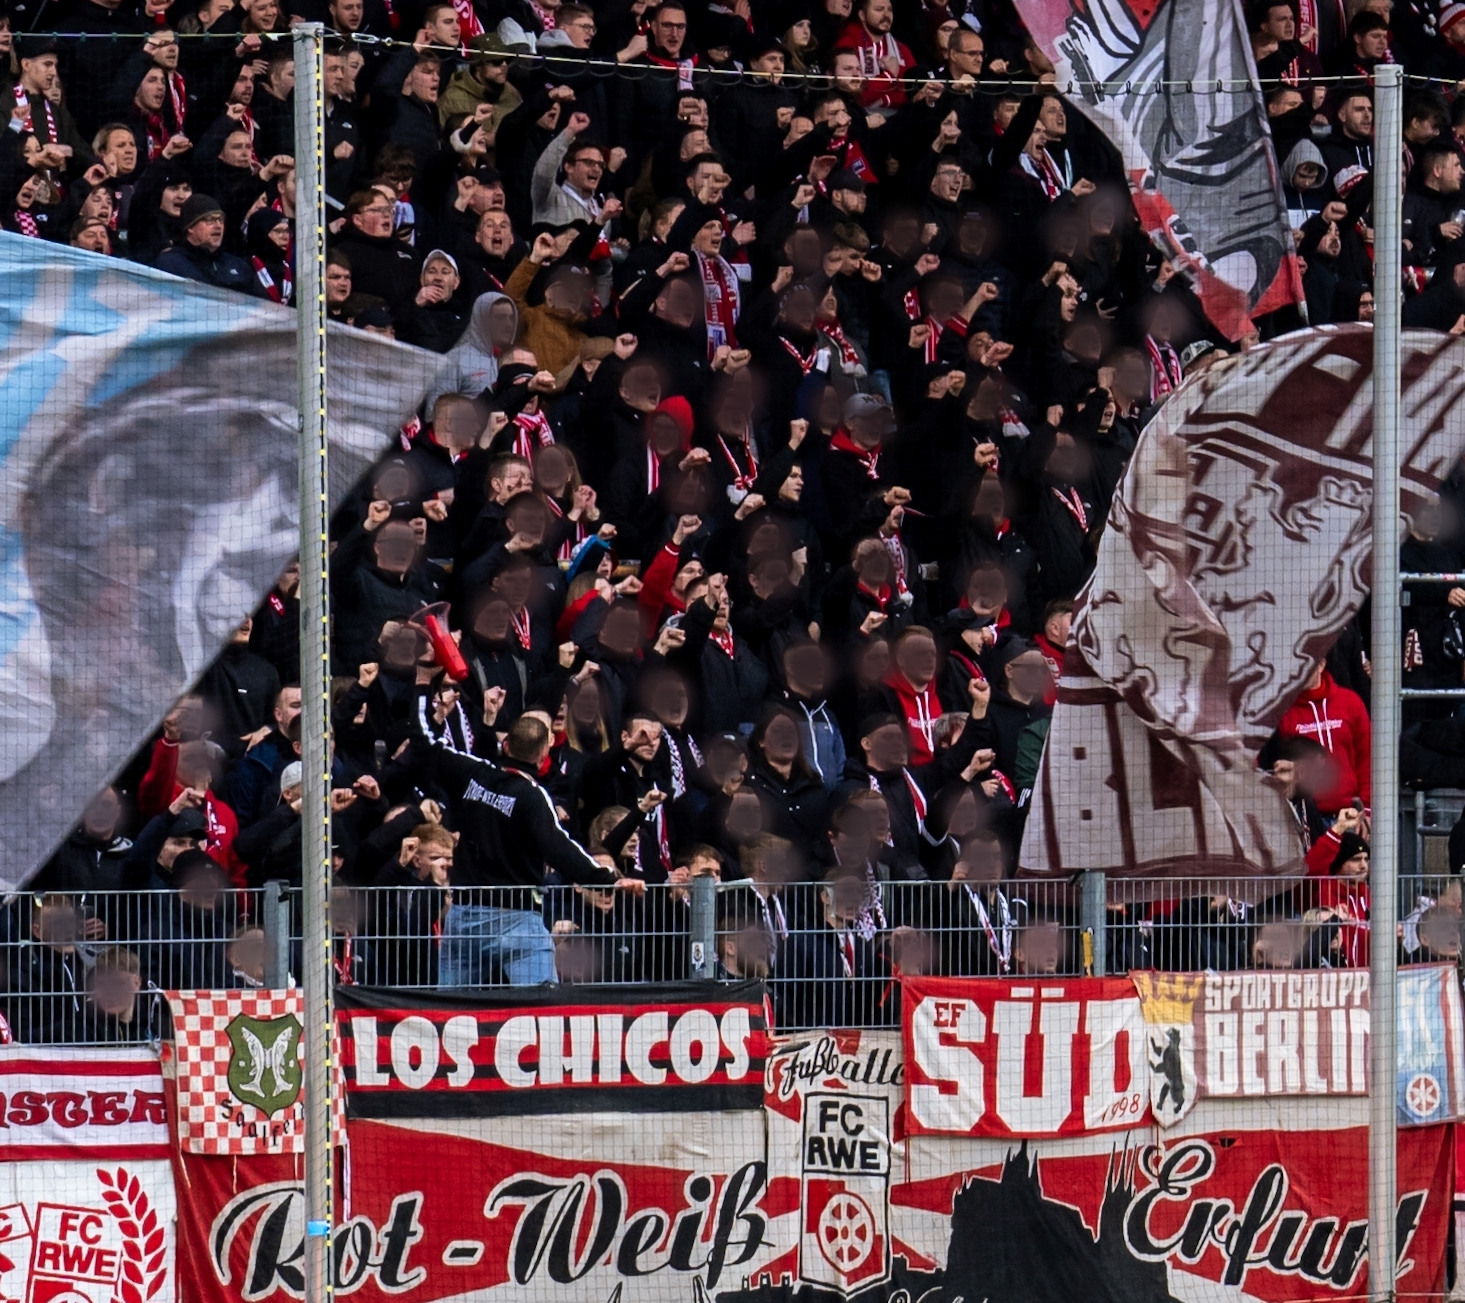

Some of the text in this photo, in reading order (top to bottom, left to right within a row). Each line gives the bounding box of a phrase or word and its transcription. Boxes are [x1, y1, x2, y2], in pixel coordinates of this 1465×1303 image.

[1204, 970, 1370, 1012] SPORTGRUPP
[933, 1002, 963, 1028] EF
[351, 1007, 752, 1089] LOS CHICOS
[910, 987, 1155, 1133] SÜD
[778, 1036, 906, 1101] Fußballc
[820, 1099, 865, 1133] FC
[1098, 1092, 1141, 1125] 1998
[806, 1138, 881, 1173] RWE
[58, 1213, 104, 1243] FC
[210, 1179, 427, 1302] Rot
[483, 1159, 776, 1290] Weiß
[37, 1243, 119, 1280] RWE
